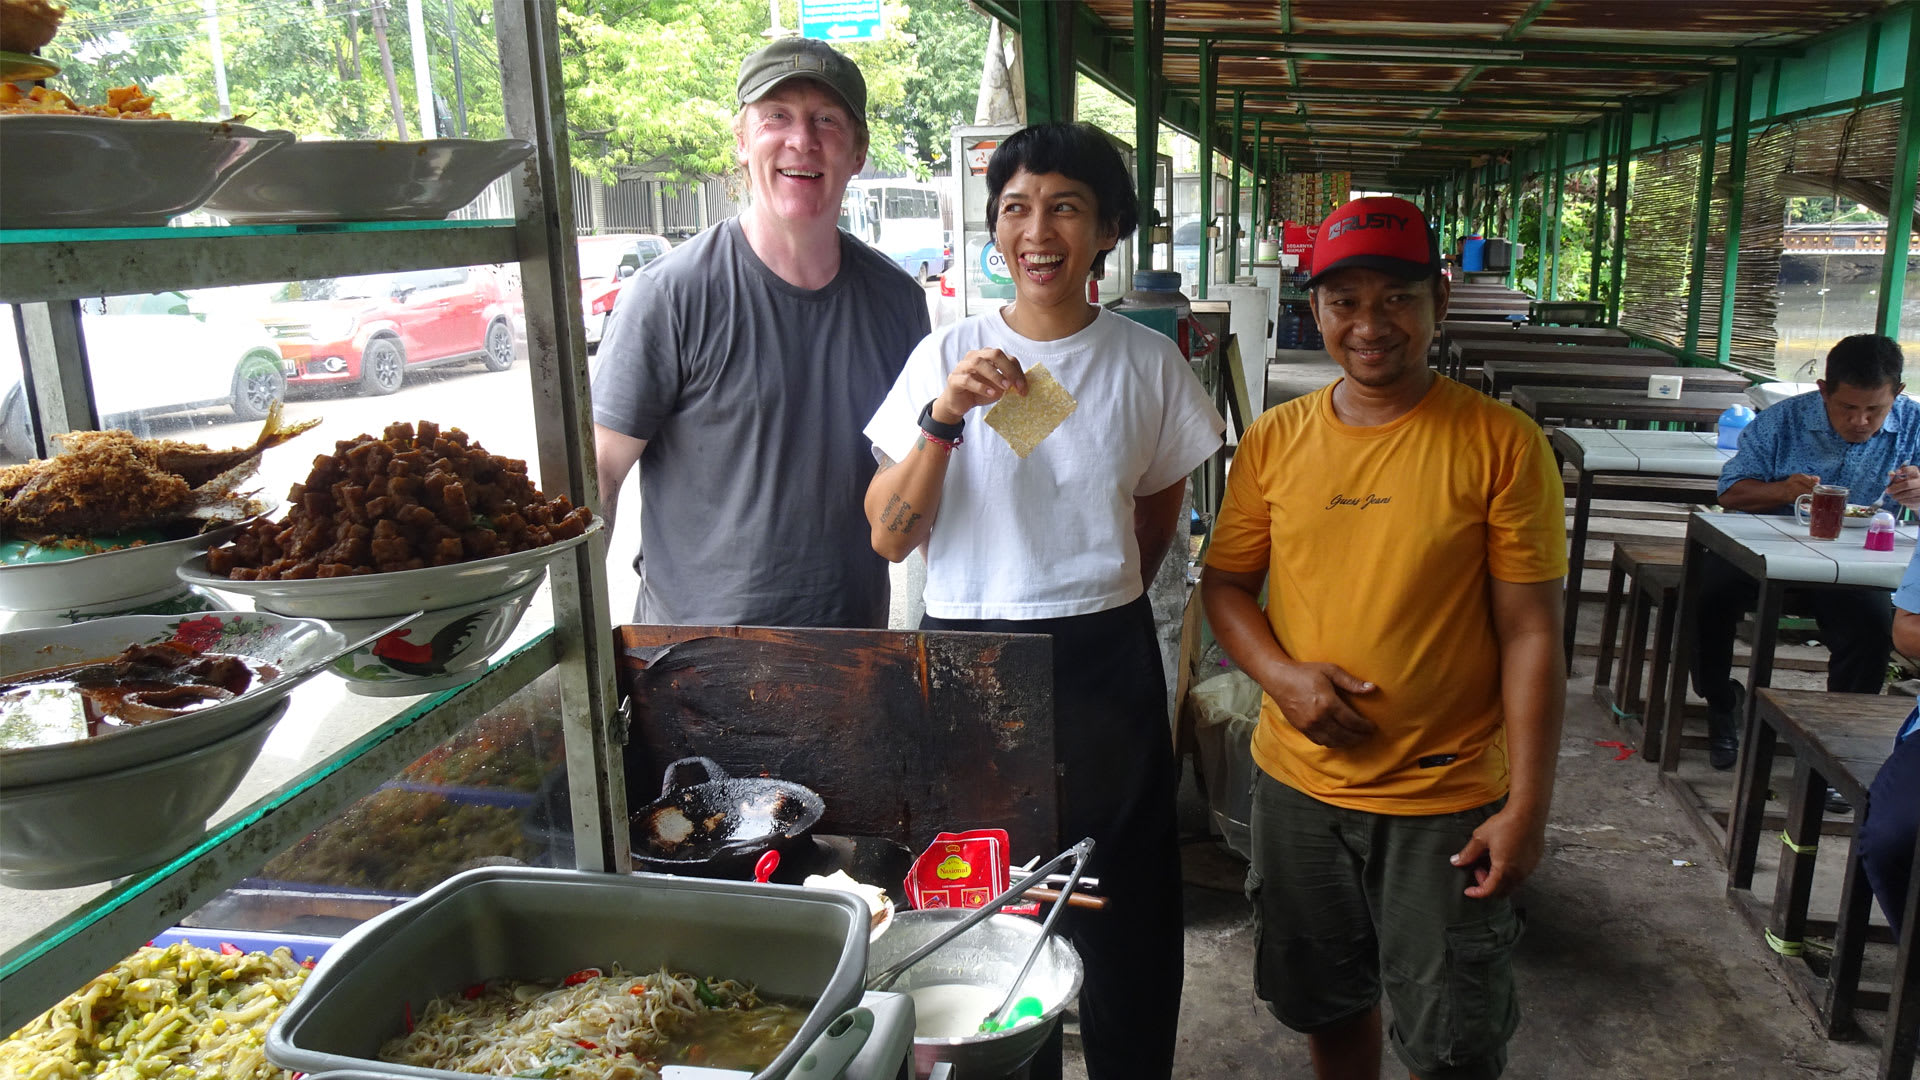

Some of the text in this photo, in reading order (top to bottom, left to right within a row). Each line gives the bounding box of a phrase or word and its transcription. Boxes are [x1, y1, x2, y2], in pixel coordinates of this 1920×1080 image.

[1341, 212, 1409, 235] RUSTY
[989, 255, 1006, 265] OV
[1325, 493, 1392, 510] Guess Jeans
[940, 866, 968, 875] Nasional
